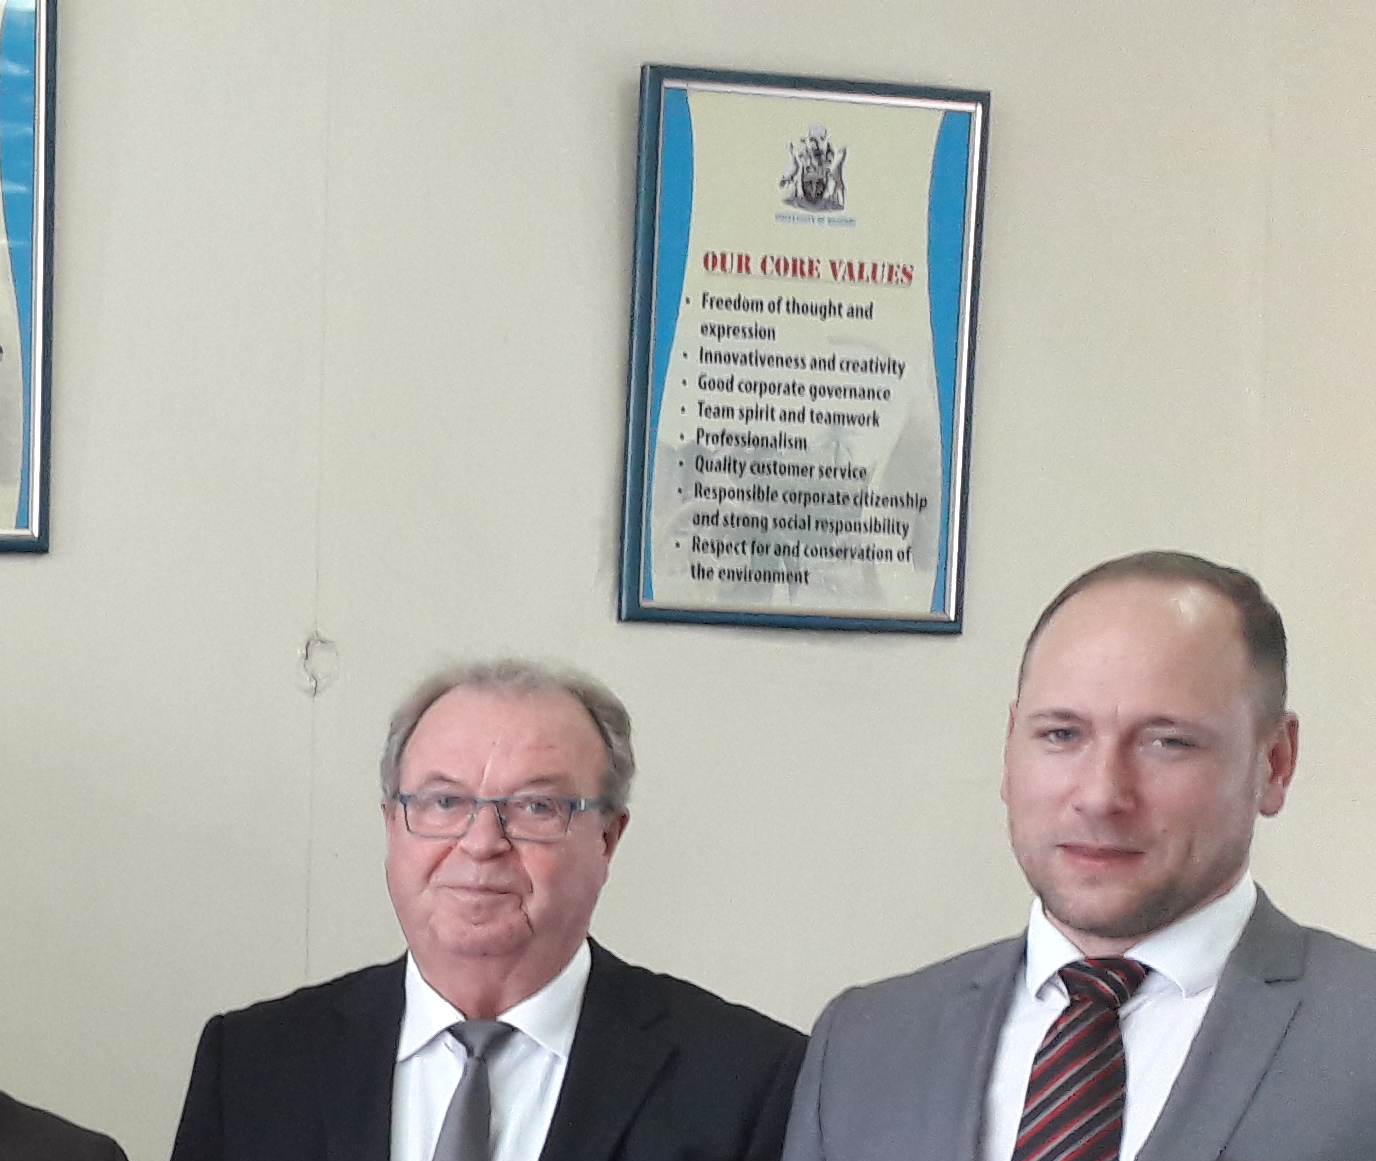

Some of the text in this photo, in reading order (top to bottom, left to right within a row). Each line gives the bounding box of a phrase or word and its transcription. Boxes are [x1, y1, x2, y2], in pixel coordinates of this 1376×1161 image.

[703, 252, 915, 286] OUR CORE VALUES
[701, 292, 874, 322] Freedom of thought and
[700, 322, 776, 342] expression
[699, 347, 906, 378] Innovativeness and creativity
[698, 374, 891, 402] Good corporate governance
[697, 402, 880, 428] Team spirit and teamwork
[696, 428, 808, 451] Professionalism
[695, 455, 867, 481] Quality customer service
[694, 483, 928, 512] Responsible corporate citizenship
[692, 511, 910, 540] and strong social responsibility
[691, 537, 911, 563] Respect for and conservation of
[690, 564, 810, 584] the environment
